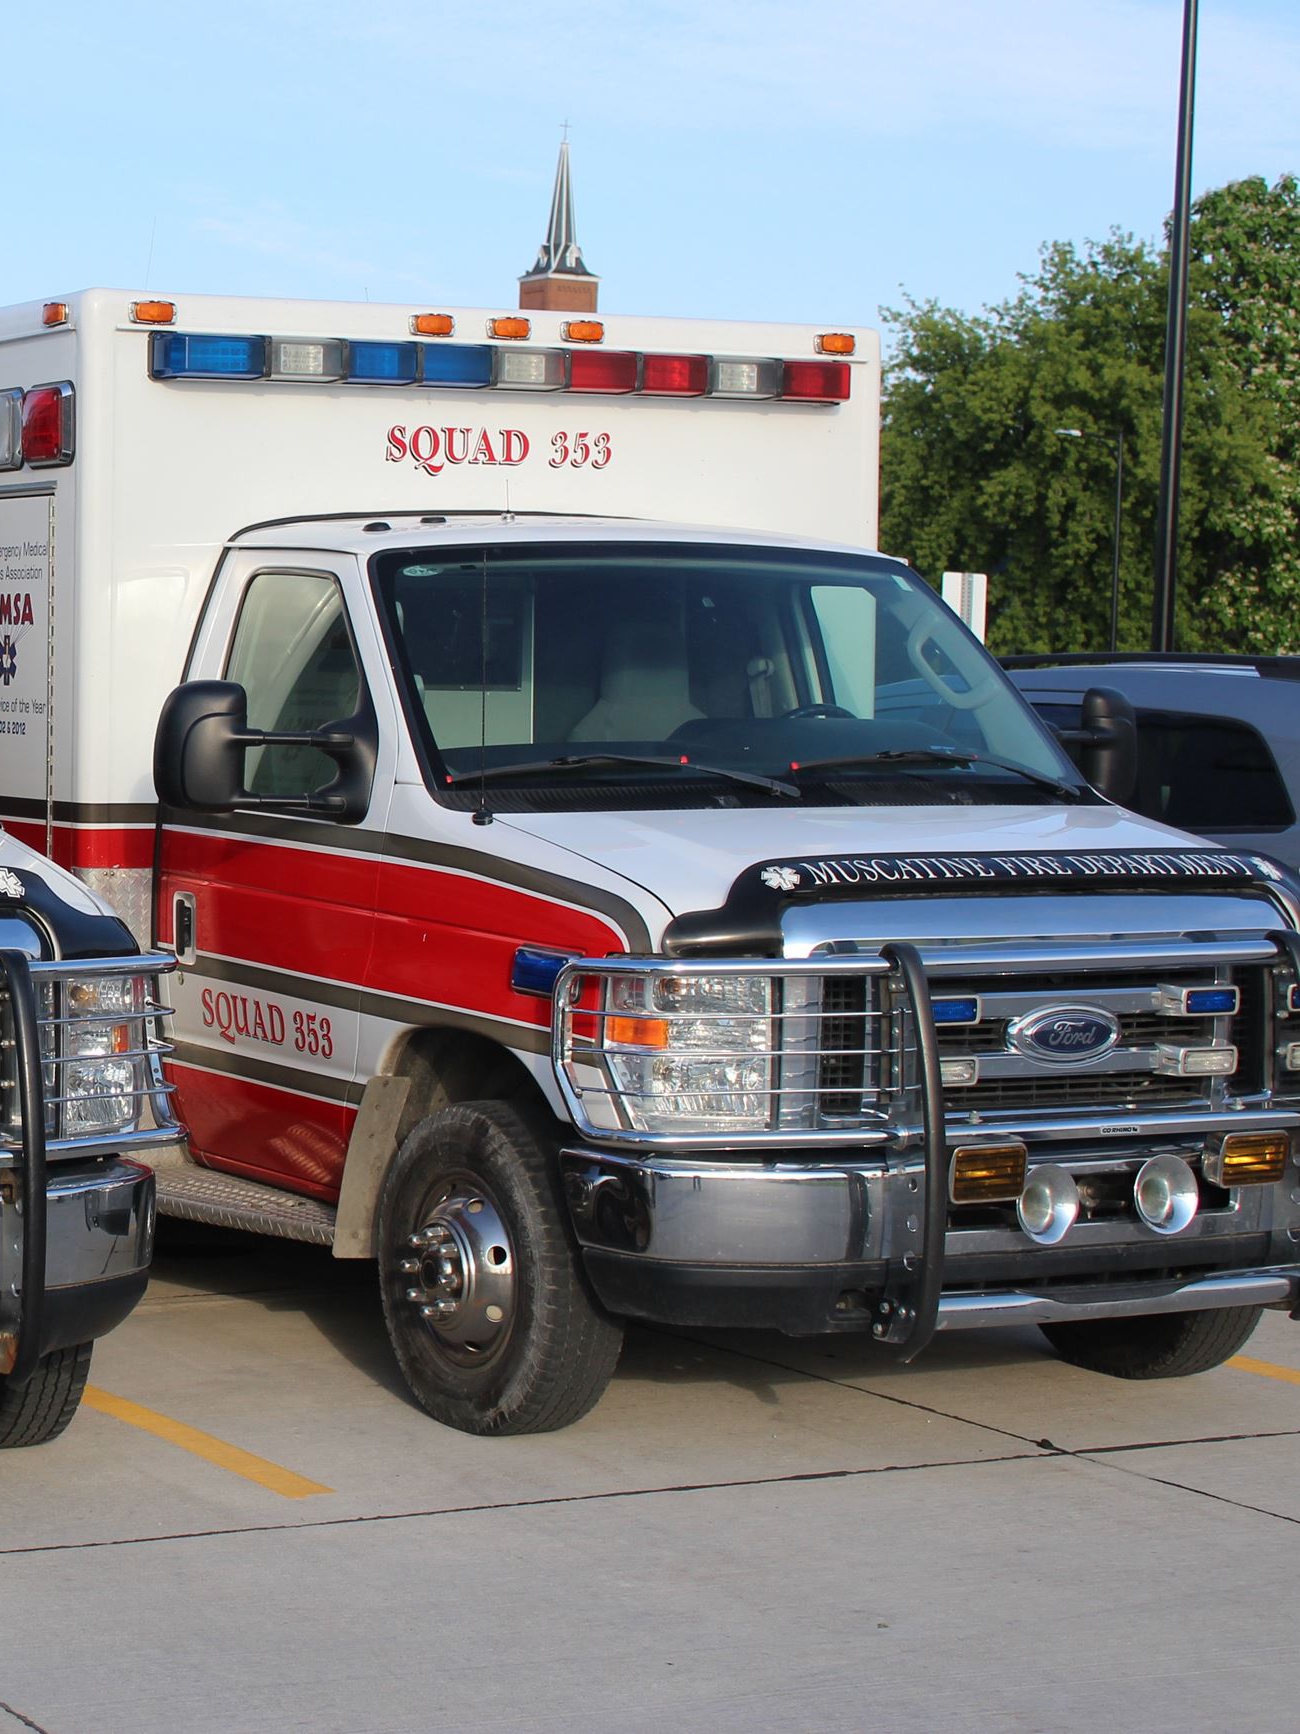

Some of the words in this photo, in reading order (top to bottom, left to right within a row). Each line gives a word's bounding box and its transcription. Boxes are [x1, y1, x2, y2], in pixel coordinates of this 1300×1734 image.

[386, 425, 530, 476] SQUAD
[549, 431, 612, 469] 353
[5, 565, 42, 580] Association
[11, 698, 18, 712] of
[19, 699, 29, 713] the
[32, 699, 46, 714] Year
[12, 721, 26, 735] 2012
[800, 857, 995, 884] MUSCATINE
[992, 856, 1073, 876] FIRE
[1067, 854, 1252, 876] DEPARTMENT
[202, 988, 285, 1045] SQUAD
[293, 1010, 333, 1059] 353
[1048, 1021, 1096, 1046] Ford
